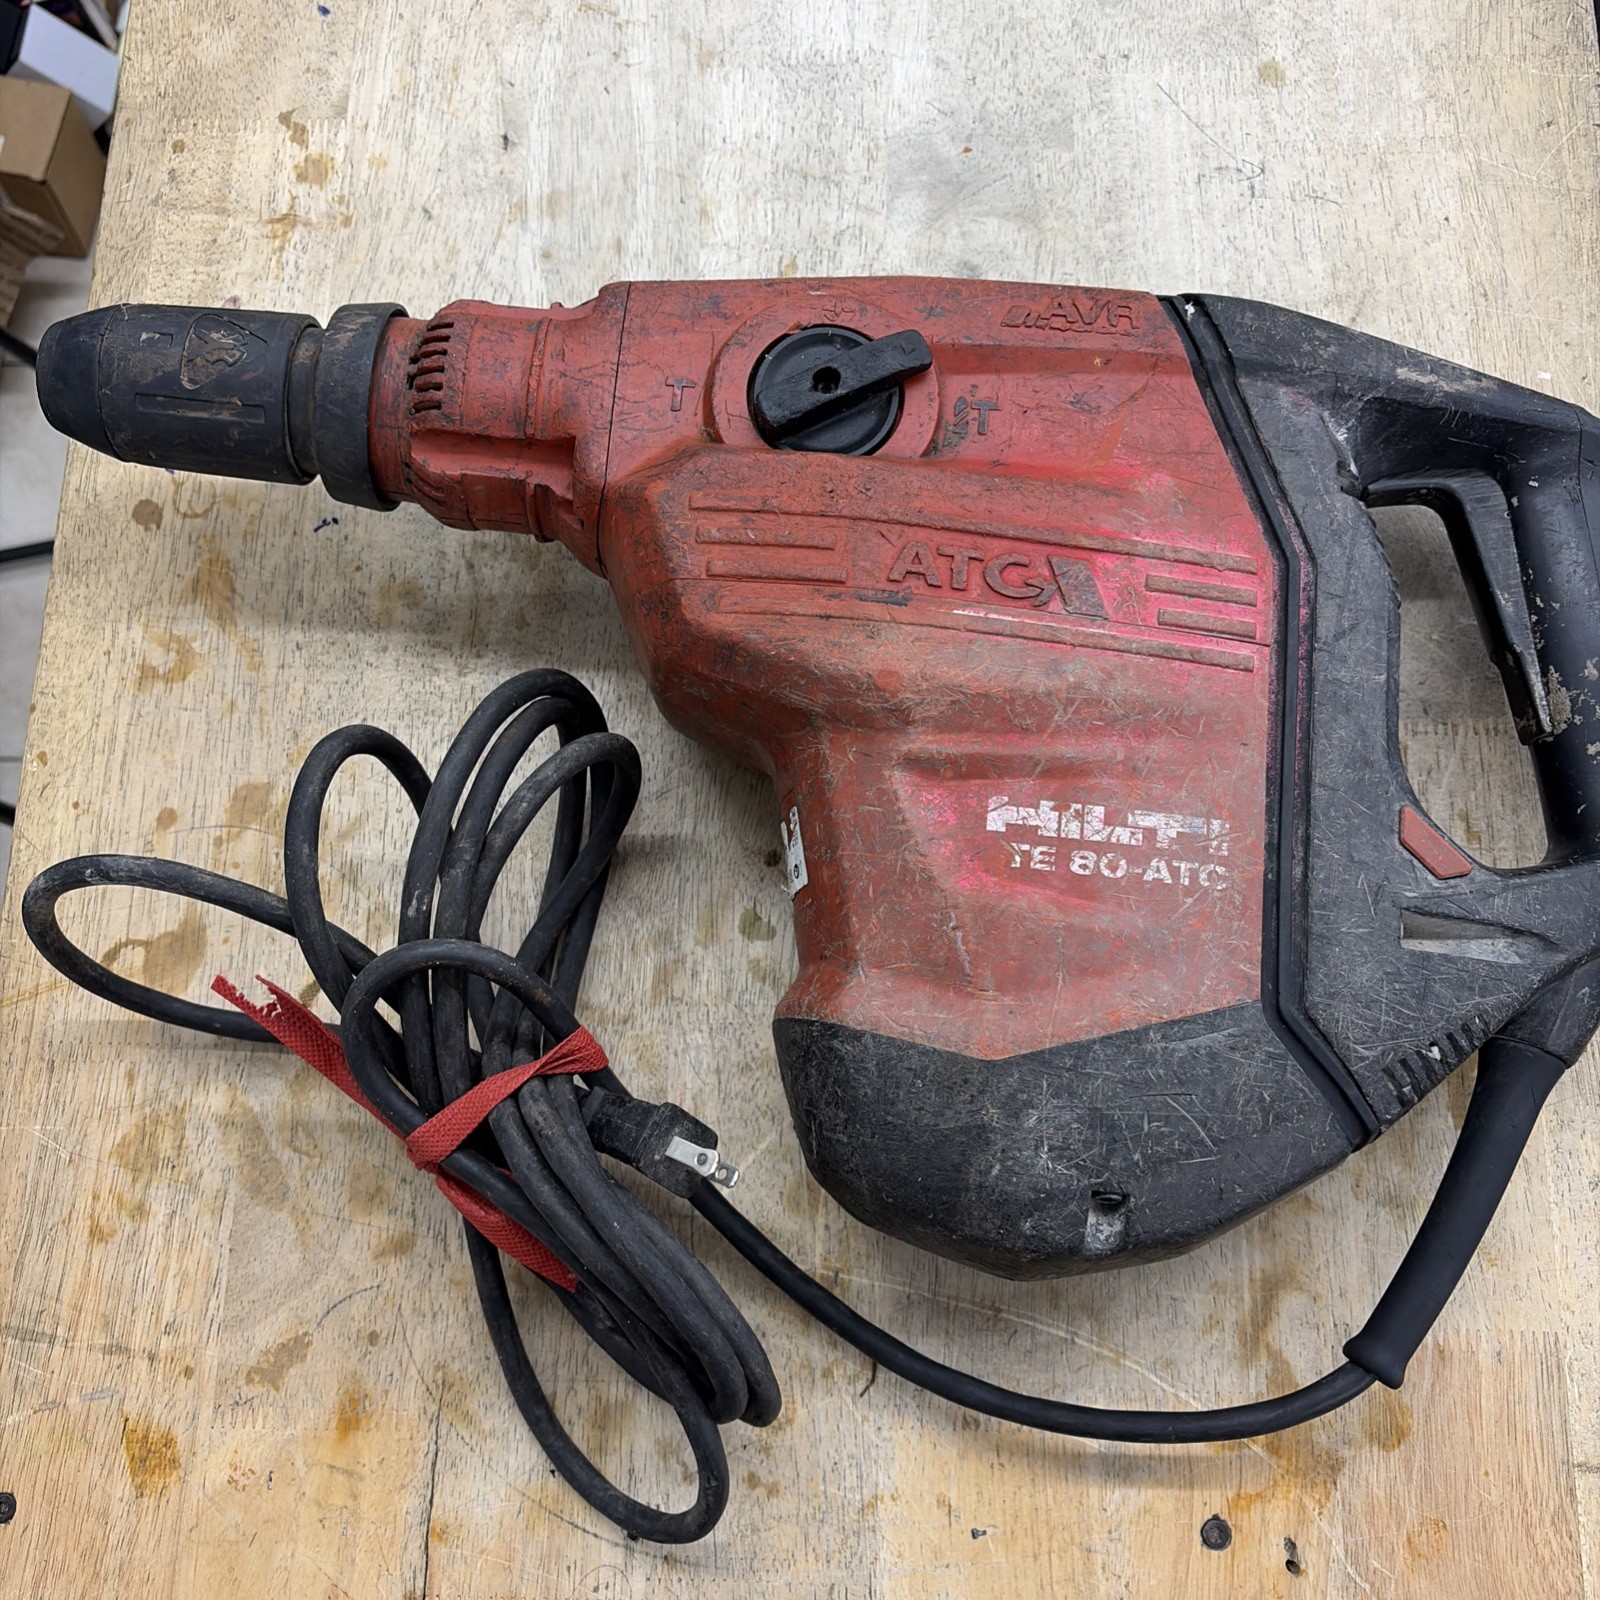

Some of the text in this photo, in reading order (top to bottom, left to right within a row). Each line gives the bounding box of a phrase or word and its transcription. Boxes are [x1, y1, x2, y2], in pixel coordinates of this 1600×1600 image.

[1043, 297, 1140, 330] AVR
[986, 796, 1230, 857] HILTI
[1008, 842, 1229, 891] TE 80-ATC
